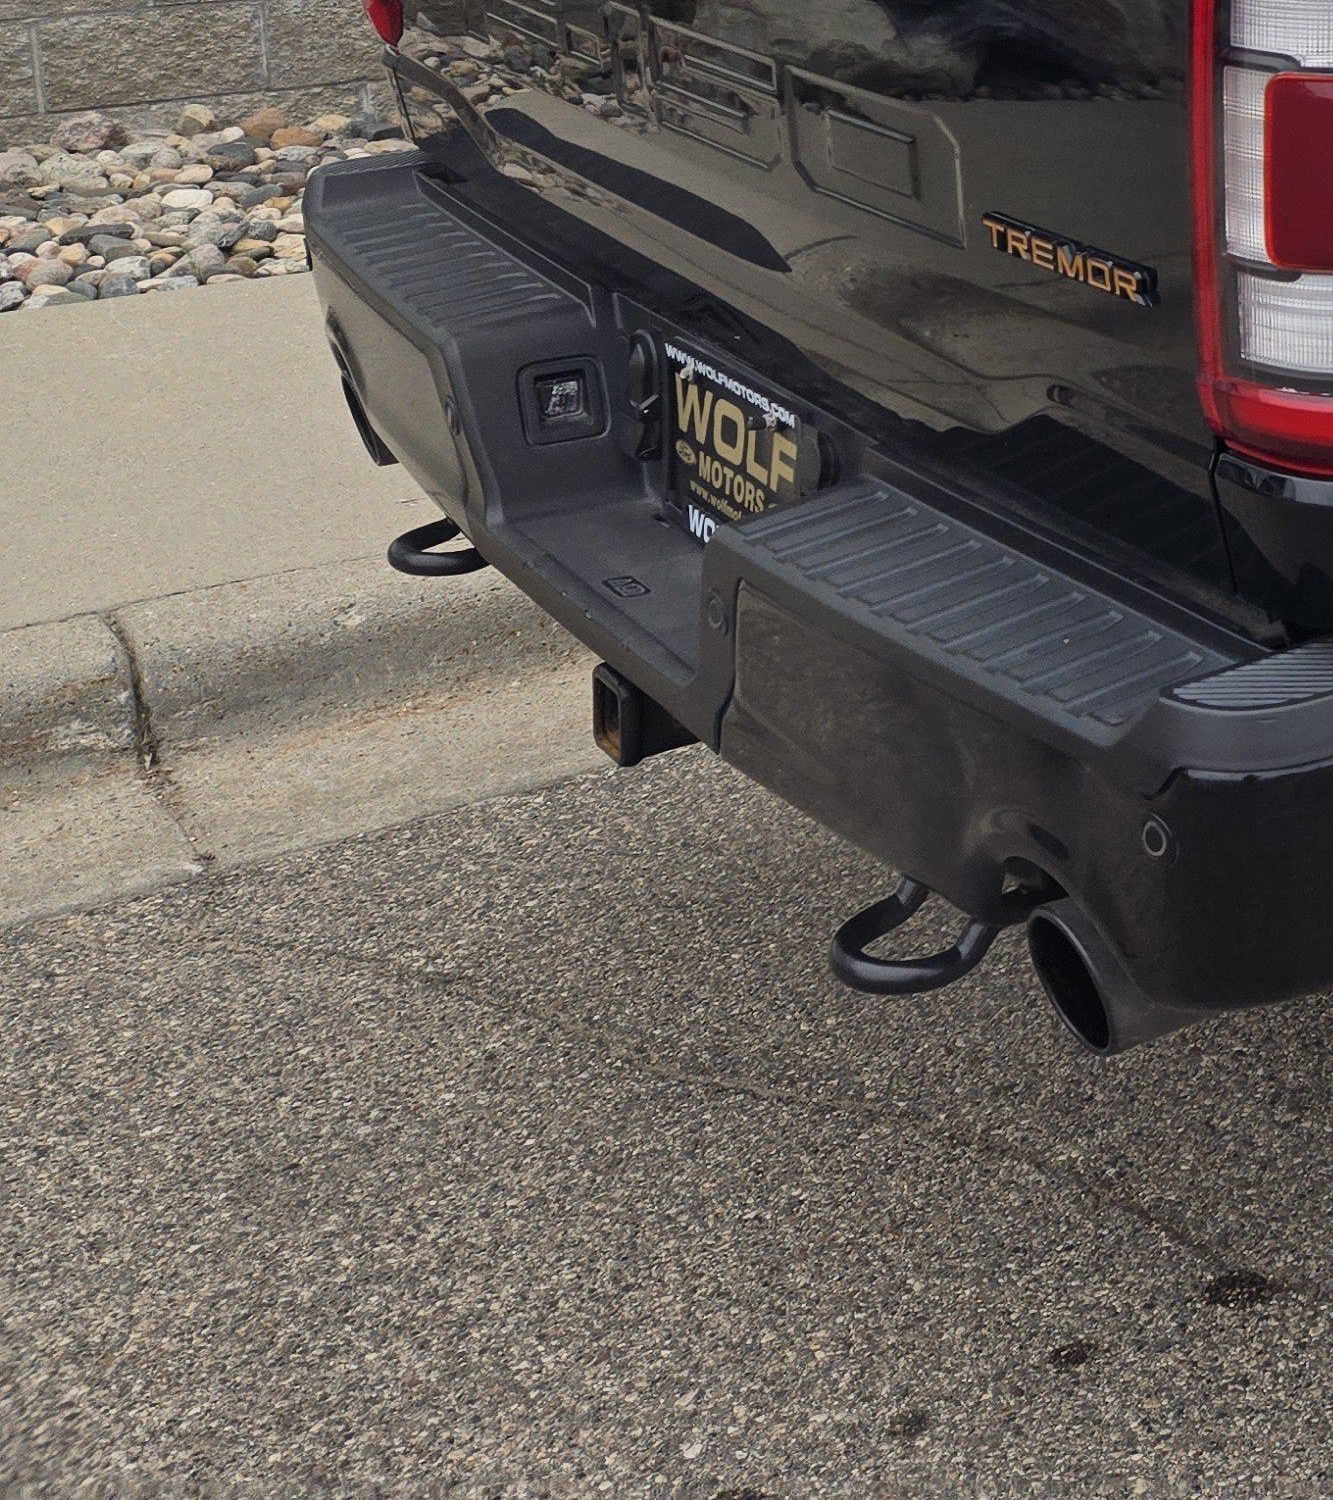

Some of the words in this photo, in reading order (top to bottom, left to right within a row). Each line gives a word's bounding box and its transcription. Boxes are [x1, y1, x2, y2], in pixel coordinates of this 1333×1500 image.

[981, 218, 1144, 305] TREMOR
[675, 372, 798, 493] WOLF
[698, 450, 765, 514] MOTORS
